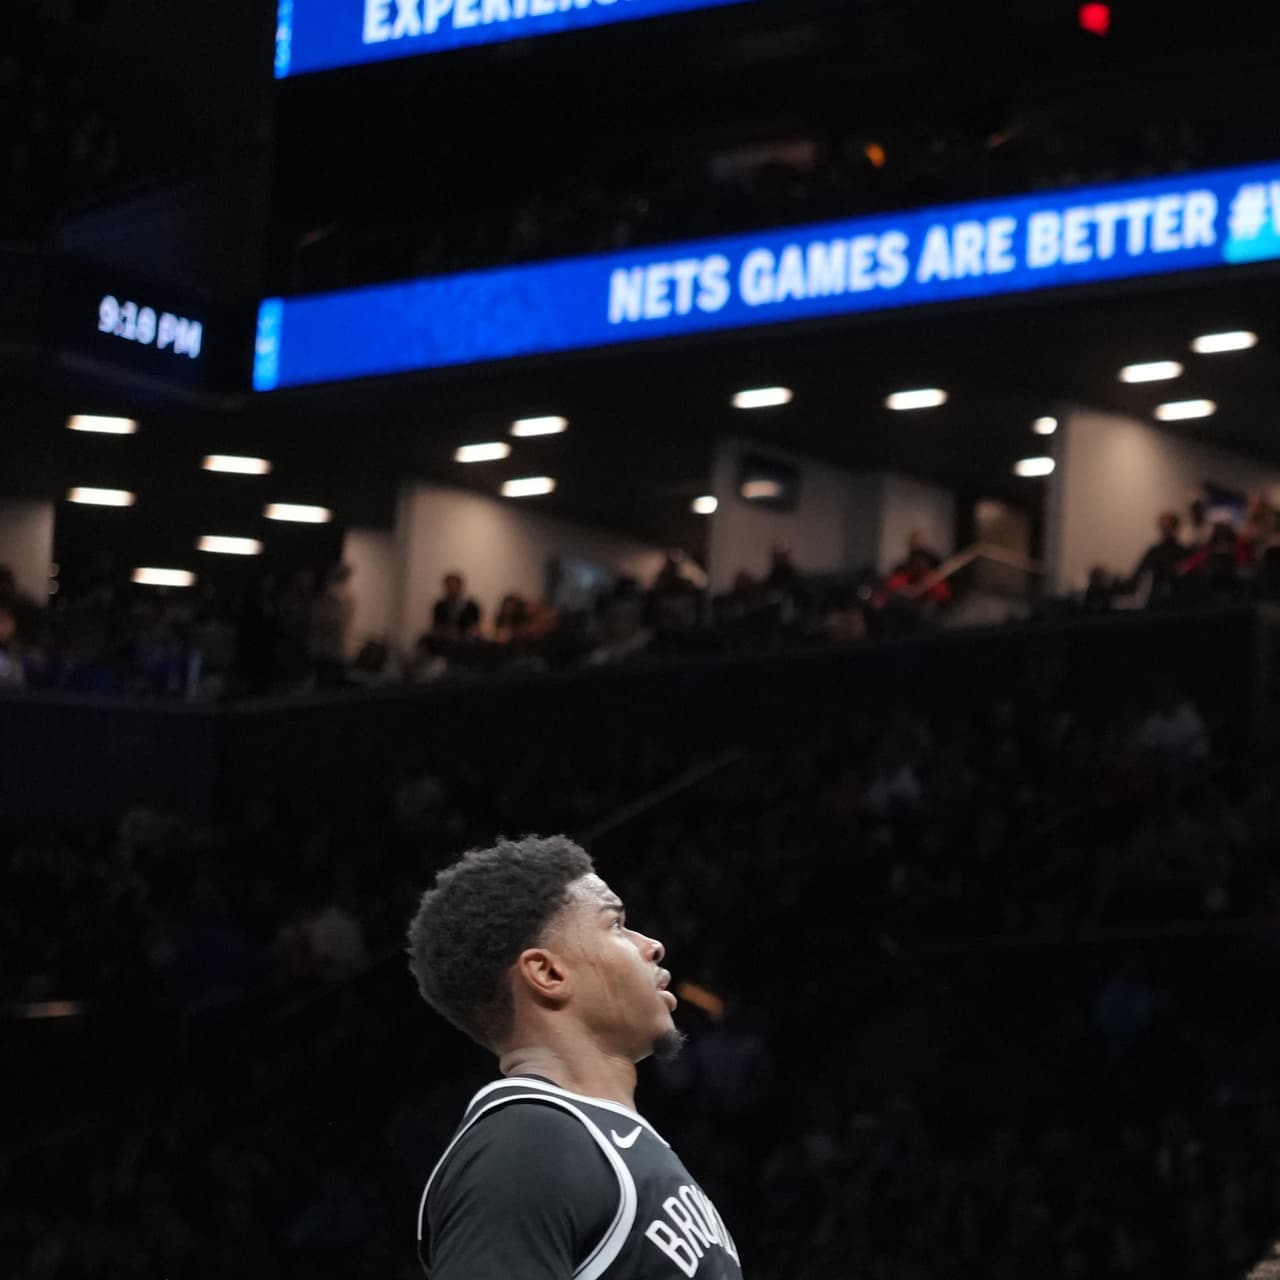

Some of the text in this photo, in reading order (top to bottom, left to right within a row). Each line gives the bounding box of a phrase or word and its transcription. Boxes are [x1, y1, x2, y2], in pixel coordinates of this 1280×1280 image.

[609, 255, 730, 325] NETS
[740, 231, 908, 304] GAMES
[916, 216, 1017, 284] ARE
[1025, 190, 1217, 270] BETTER
